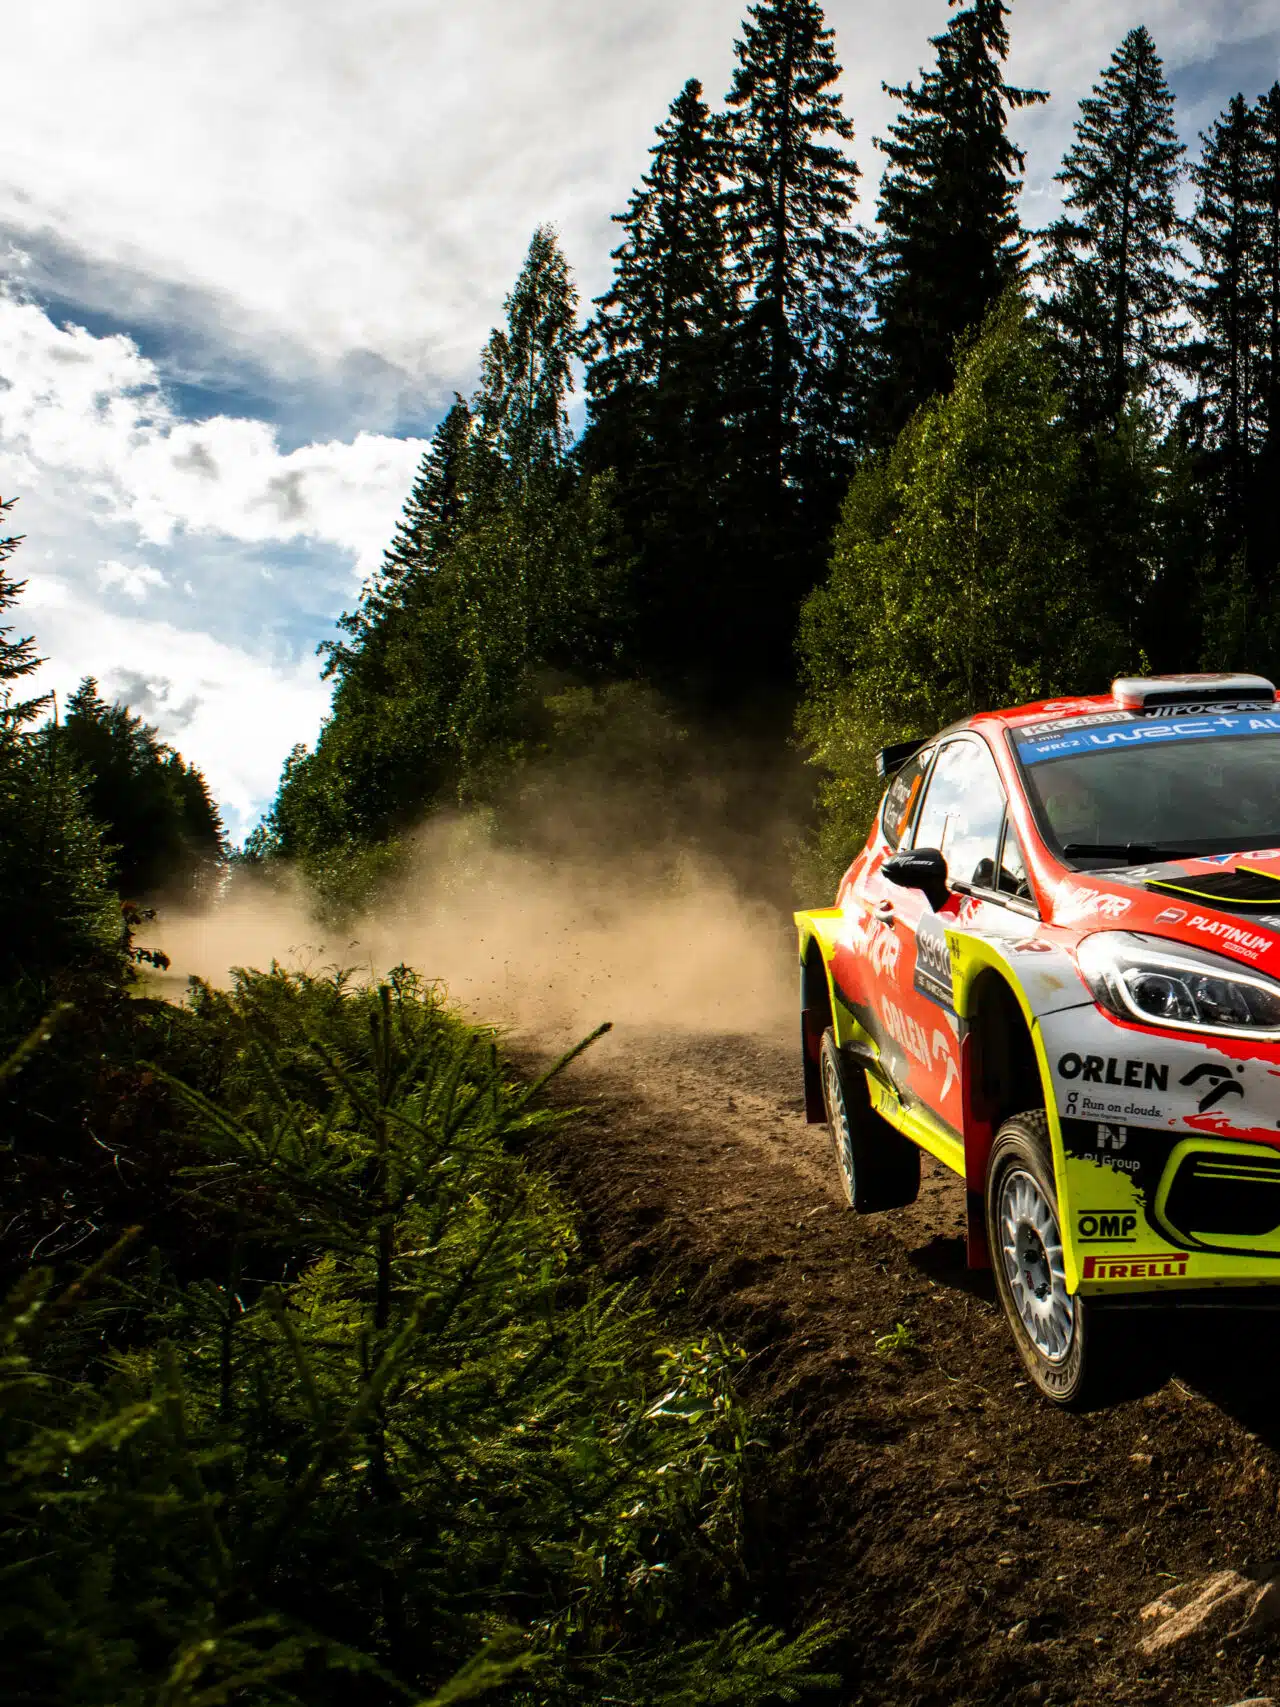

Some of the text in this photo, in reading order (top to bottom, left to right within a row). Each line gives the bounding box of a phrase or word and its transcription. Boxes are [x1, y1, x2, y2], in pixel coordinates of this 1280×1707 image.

[1036, 740, 1080, 752] WRC2
[1186, 915, 1274, 953] PLATINUM
[881, 993, 933, 1072] ORLEN
[1057, 1052, 1169, 1091] ORLEN
[1082, 1097, 1164, 1117] Run on clouds.
[1101, 1155, 1141, 1173] Group
[1078, 1215, 1137, 1237] OMP
[1083, 1253, 1190, 1279] PIRELLI
